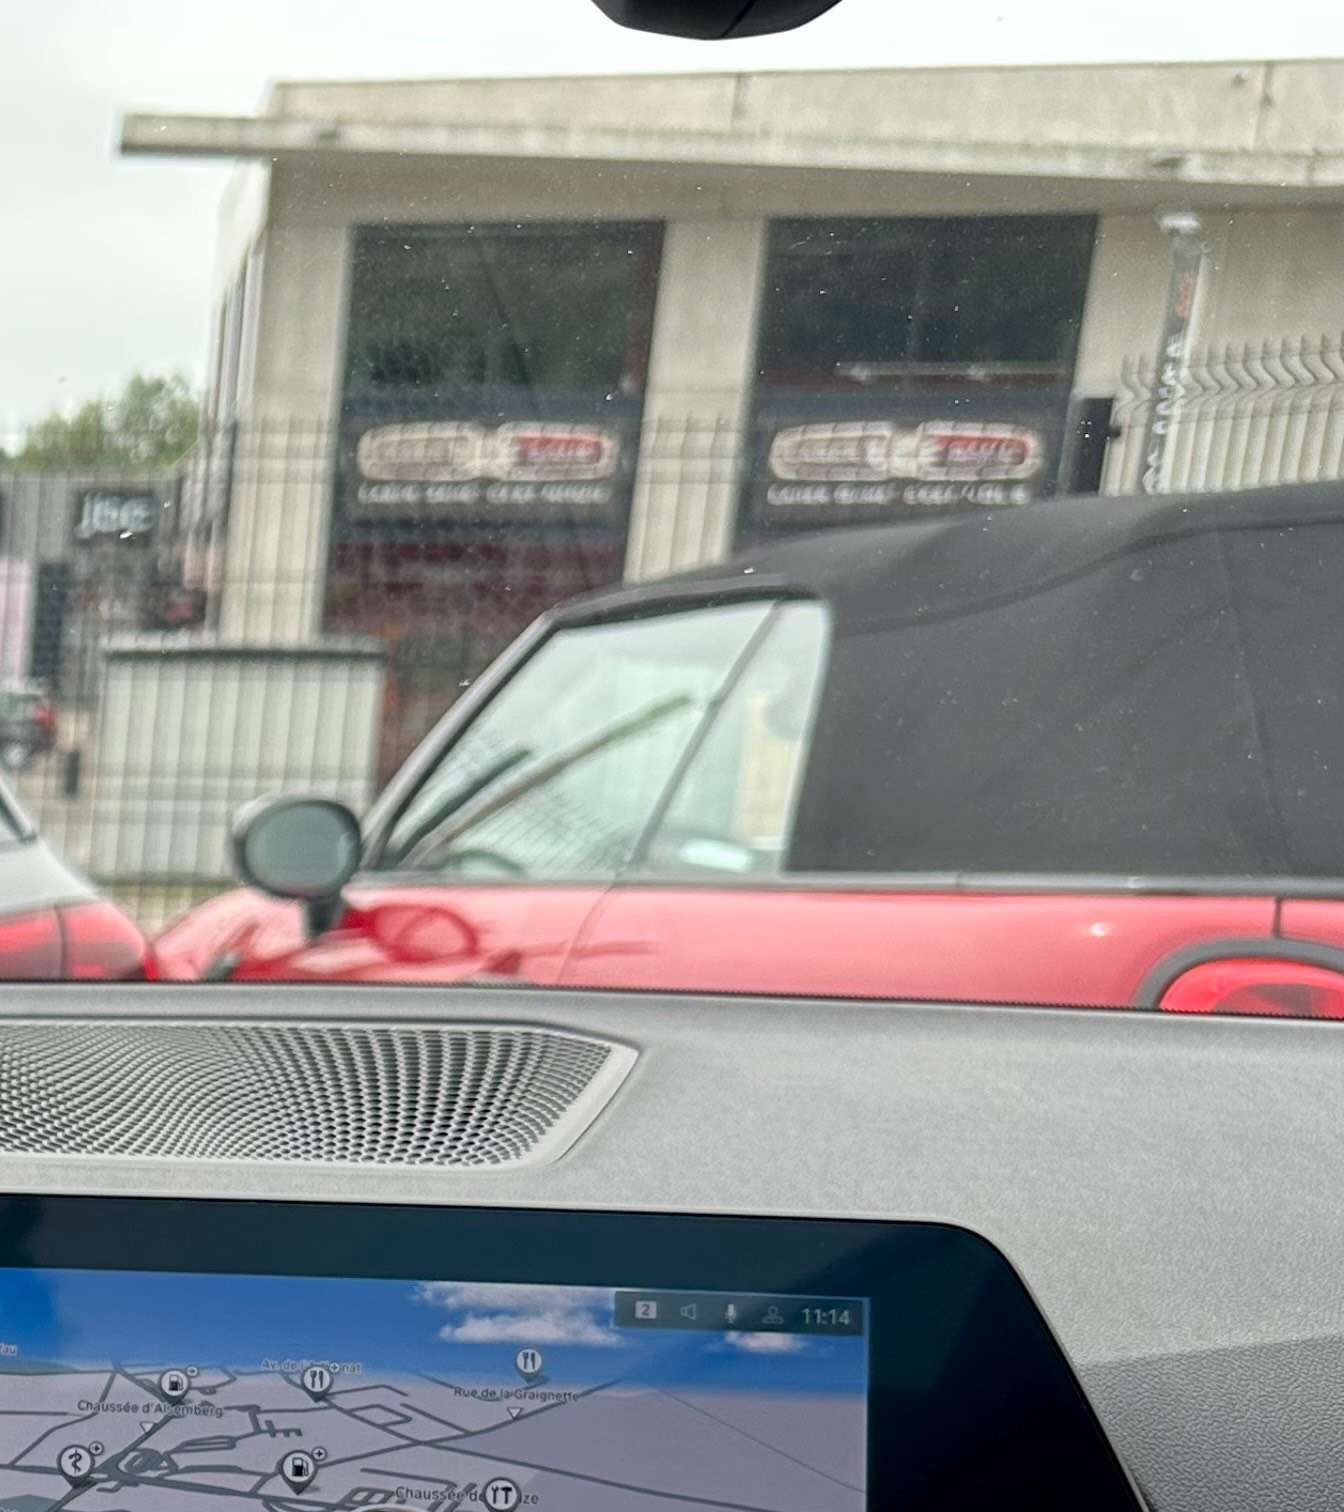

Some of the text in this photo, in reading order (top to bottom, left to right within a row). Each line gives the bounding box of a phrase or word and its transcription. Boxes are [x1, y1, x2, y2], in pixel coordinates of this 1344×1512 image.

[802, 1307, 850, 1325] 11:14
[454, 1387, 477, 1397] Rue
[481, 1388, 497, 1398] de
[500, 1389, 511, 1398] la
[77, 1400, 139, 1413] Chaussée
[395, 1486, 466, 1501] Chaussée
